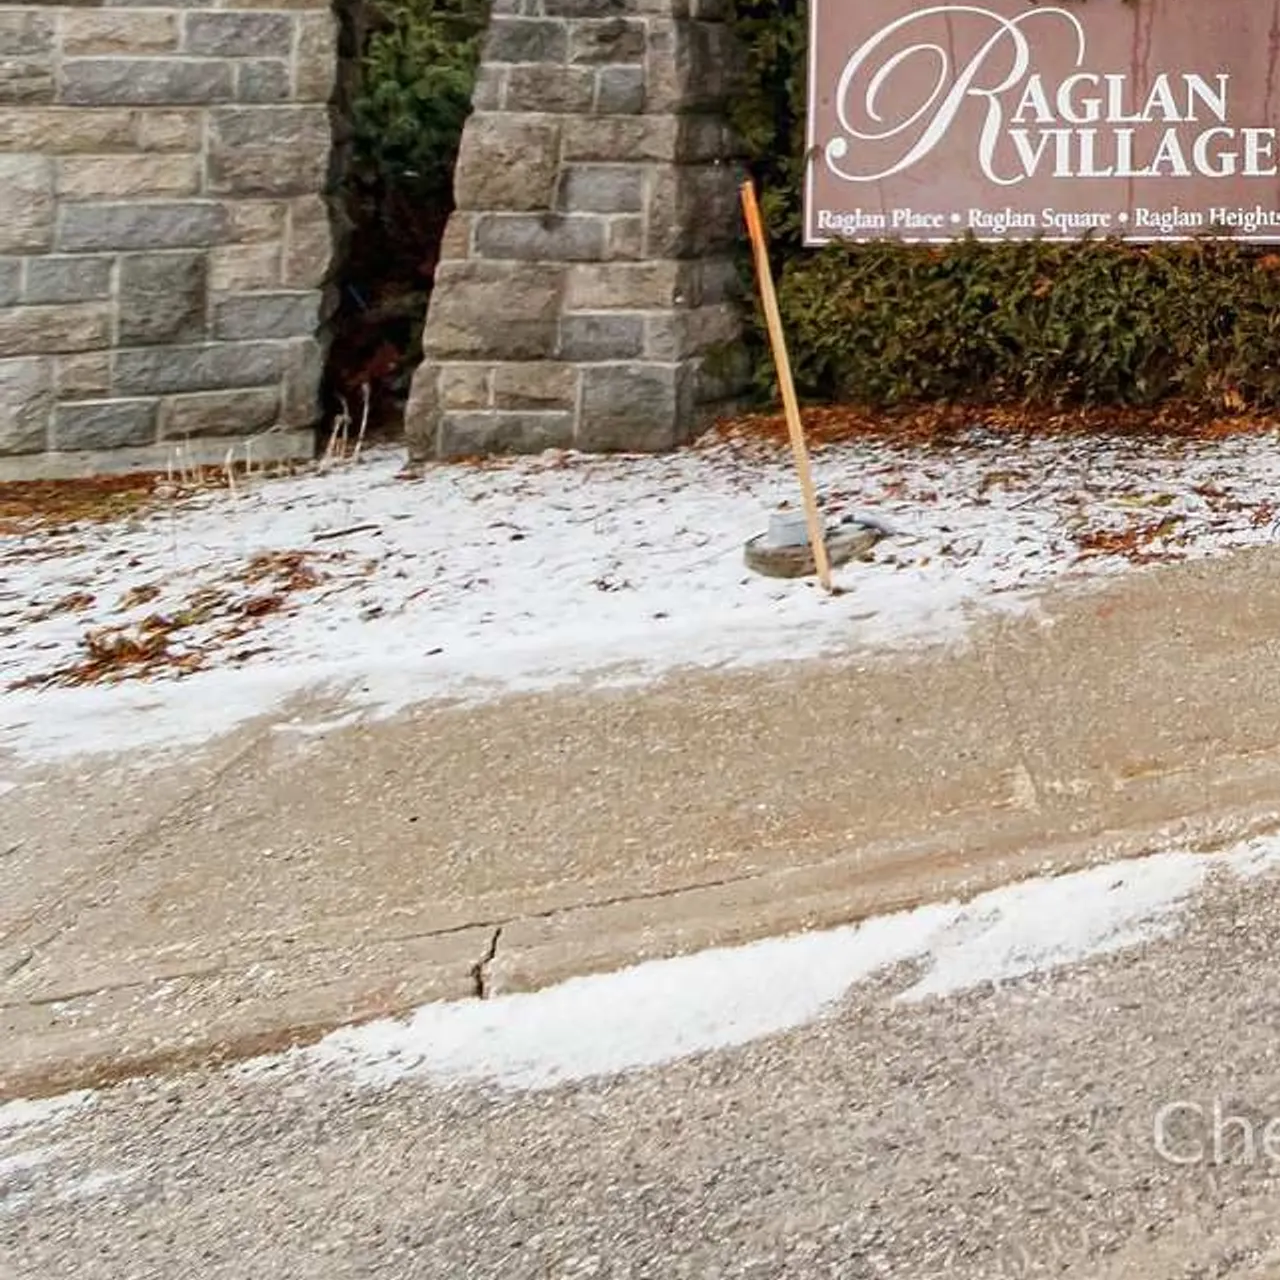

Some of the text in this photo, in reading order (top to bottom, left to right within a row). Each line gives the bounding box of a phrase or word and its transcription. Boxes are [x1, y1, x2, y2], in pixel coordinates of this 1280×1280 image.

[825, 5, 1230, 185] RAGLAN
[1007, 127, 1278, 178] VILLAGE
[817, 208, 886, 234] Raglan
[891, 207, 945, 229] Place
[967, 207, 1035, 233] Raglan
[1041, 208, 1112, 233] Square
[1134, 205, 1203, 232] Raglan
